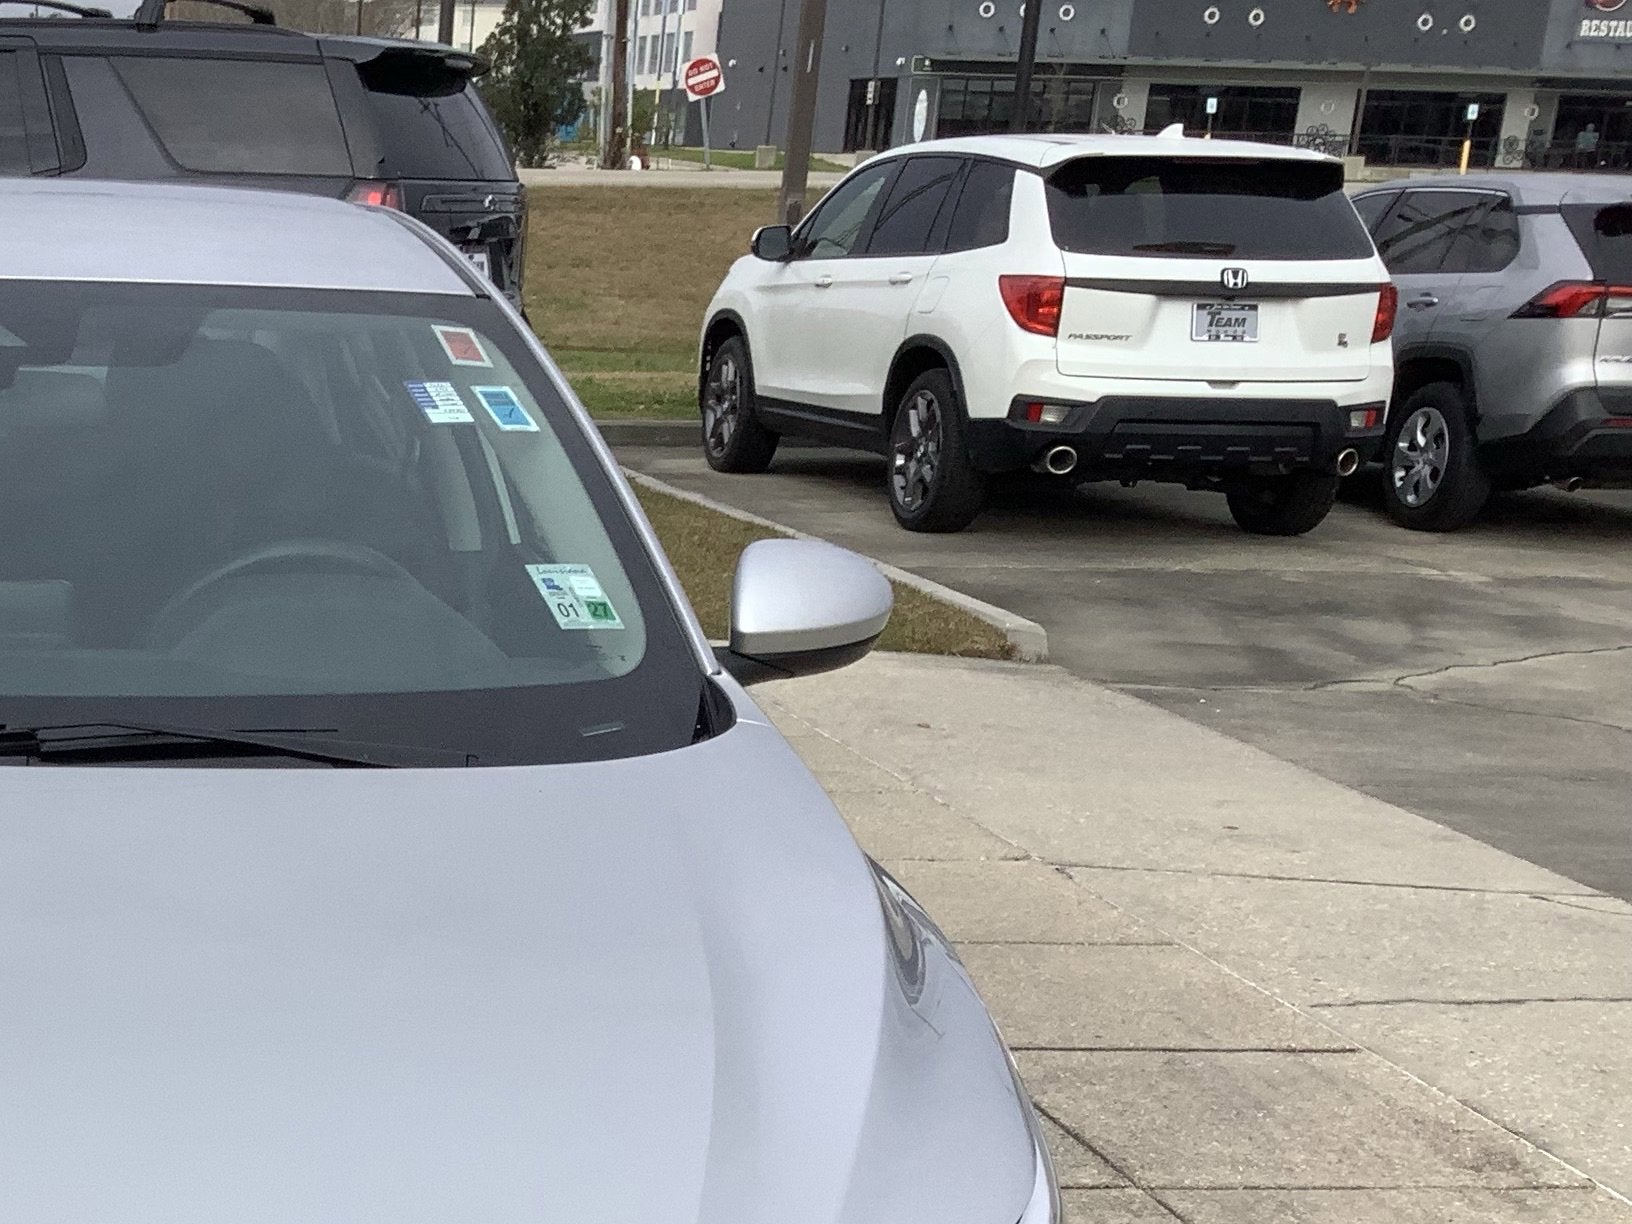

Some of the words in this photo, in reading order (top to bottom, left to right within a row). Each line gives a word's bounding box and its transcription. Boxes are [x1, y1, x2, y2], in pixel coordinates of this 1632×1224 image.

[699, 62, 713, 72] NOT
[694, 79, 715, 91] ENTER
[1067, 332, 1133, 341] PASSPORT
[557, 602, 580, 618] 01
[589, 602, 609, 618] 27
